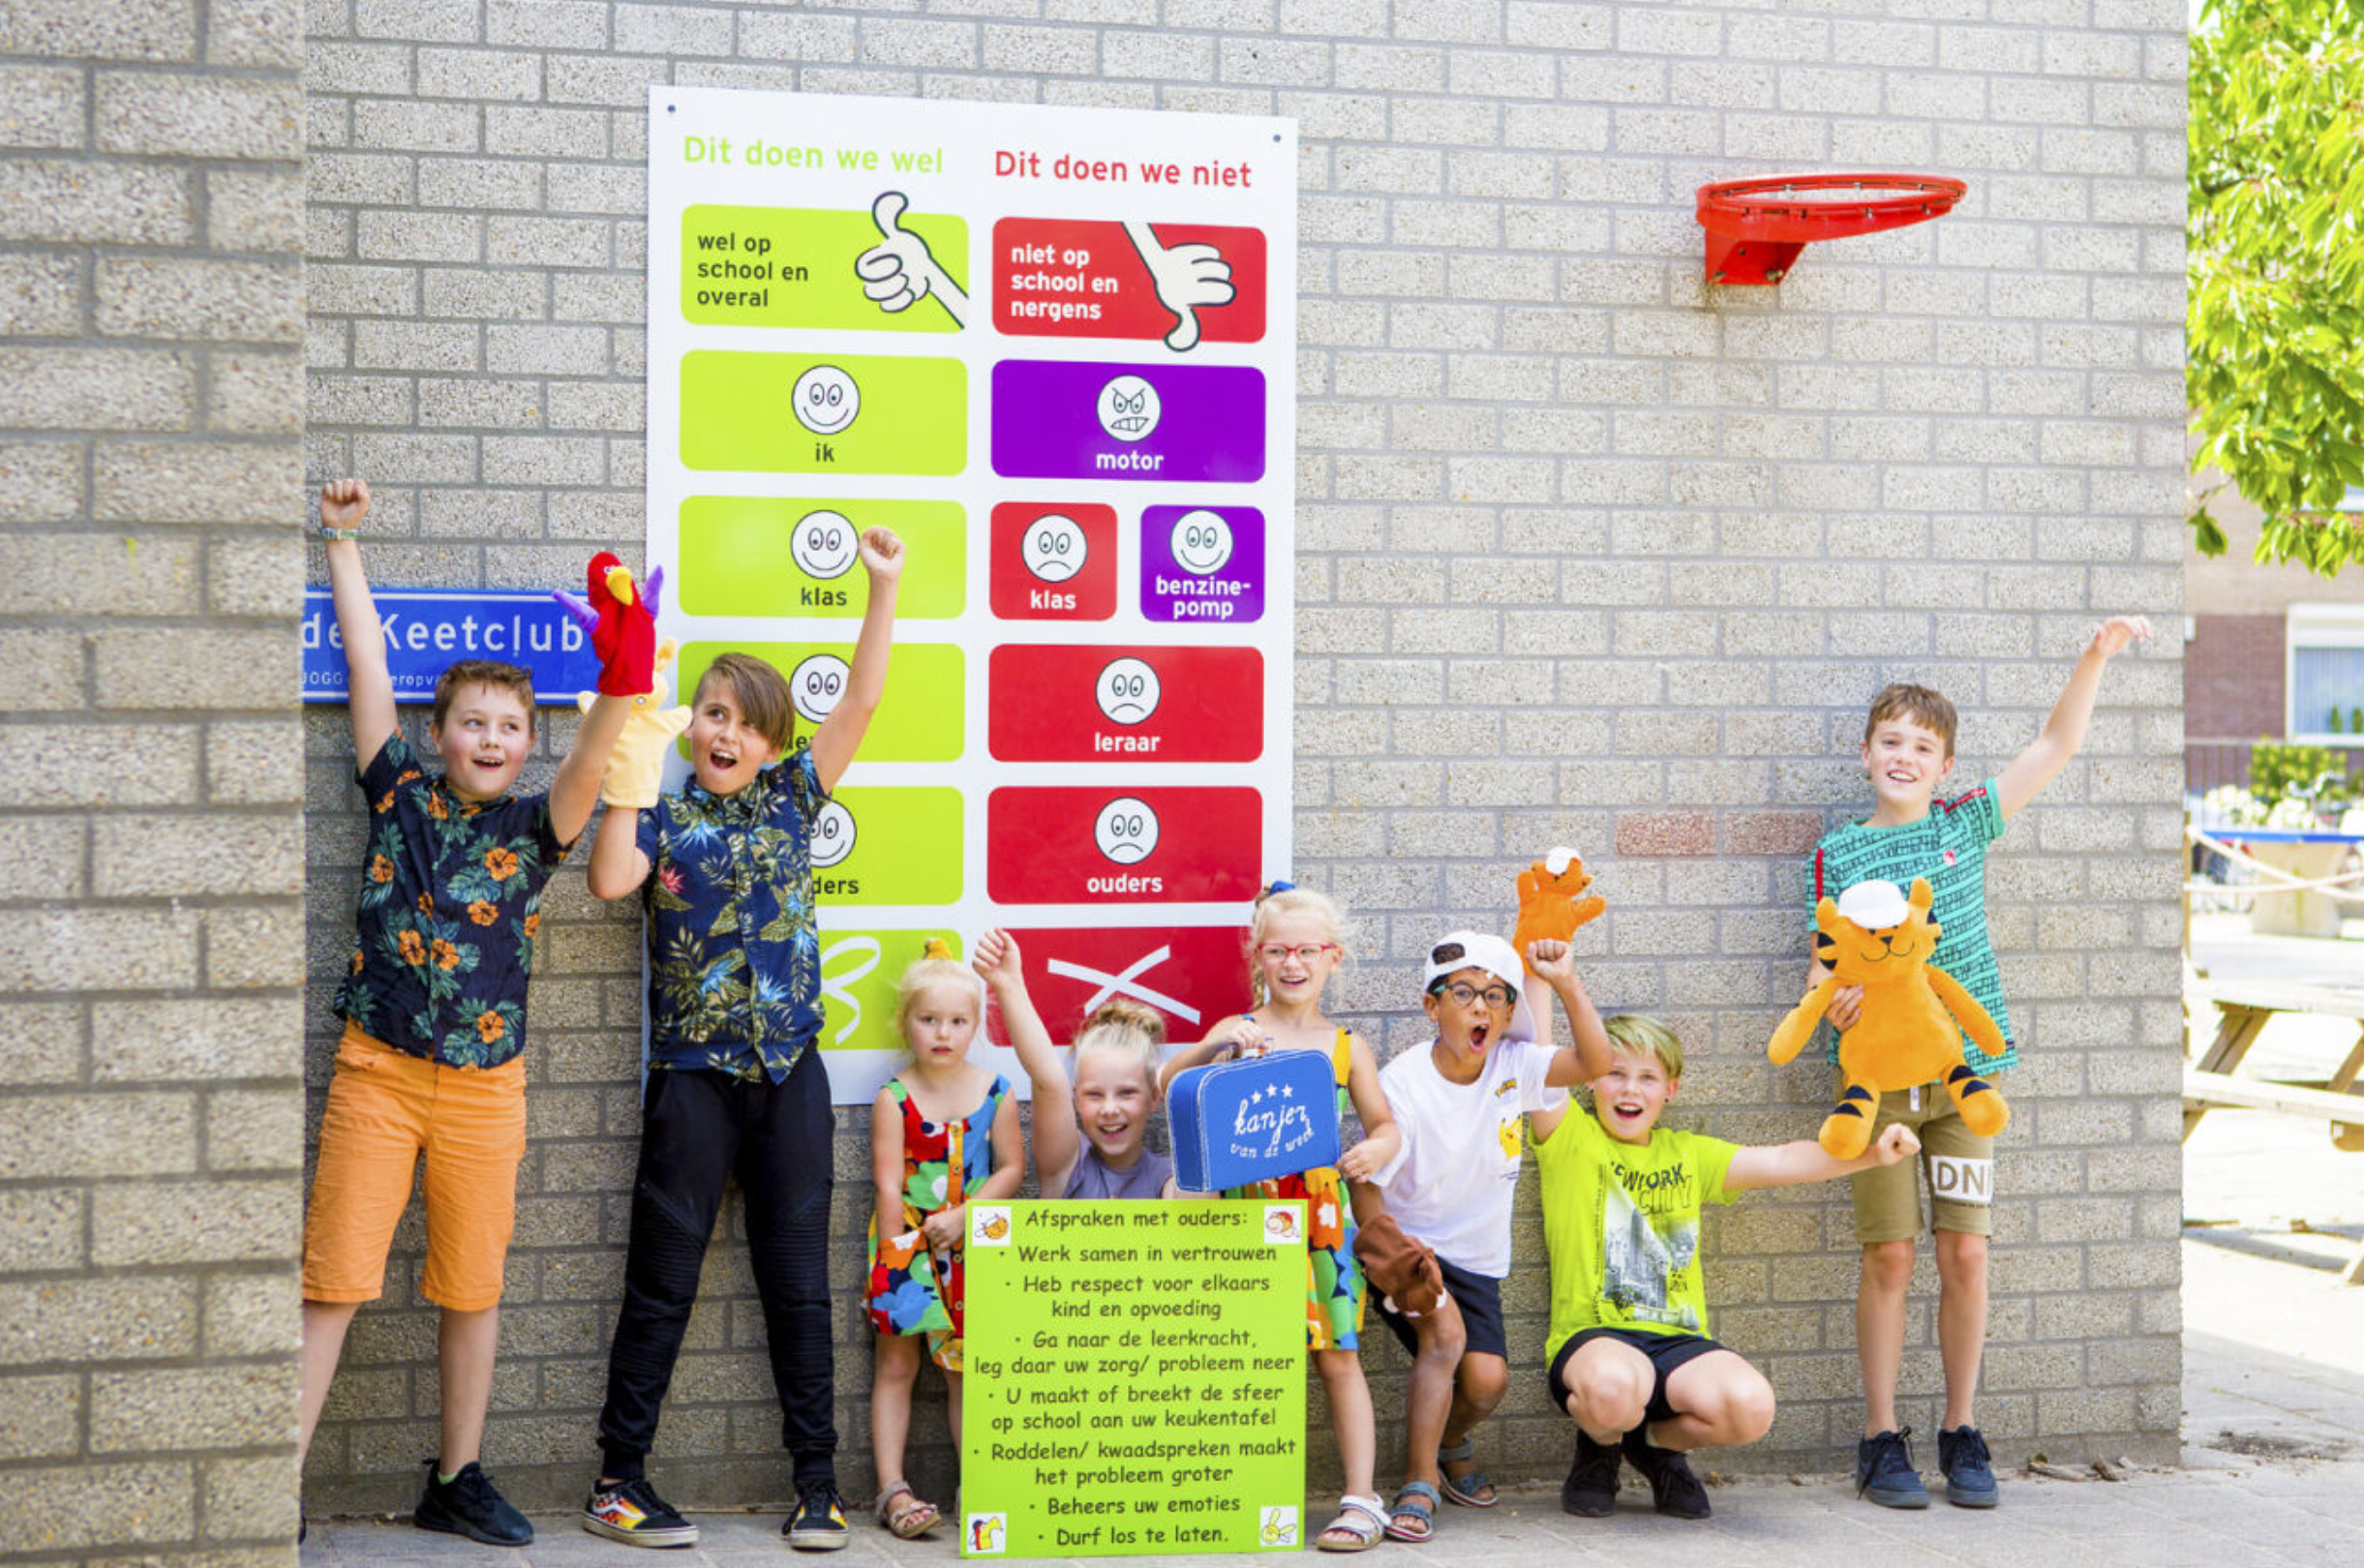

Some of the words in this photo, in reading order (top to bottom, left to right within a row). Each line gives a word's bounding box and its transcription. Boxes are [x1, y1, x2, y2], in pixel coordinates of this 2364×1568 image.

[684, 136, 731, 164] Dit
[745, 140, 823, 167] doen
[837, 150, 878, 170] we
[892, 148, 942, 173] wel
[996, 151, 1040, 177] Dit
[1054, 155, 1127, 181] doen
[1140, 164, 1180, 184] we
[1194, 161, 1251, 187] niet
[698, 232, 735, 251] wel
[744, 237, 771, 256] op
[1012, 243, 1055, 264] niet
[1063, 250, 1089, 269] op
[698, 260, 772, 280] school
[782, 266, 807, 281] en
[1012, 271, 1084, 291] school
[1092, 278, 1118, 293] en
[697, 288, 768, 307] overal
[1012, 301, 1101, 321] nergens
[816, 443, 833, 462] ik
[1097, 450, 1164, 469] motor
[1156, 576, 1251, 595] benzine-
[802, 587, 846, 606] klas
[1031, 589, 1076, 609] klas
[1172, 602, 1232, 620] pomp
[1095, 733, 1161, 751] leraar
[811, 875, 860, 894] ders
[1087, 874, 1163, 892] ouders
[1234, 1099, 1306, 1145] kanjer
[1230, 1143, 1257, 1158] van
[1026, 1210, 1124, 1231] Afspraken
[1134, 1211, 1168, 1225] met
[1178, 1209, 1248, 1225] ouders:
[1018, 1245, 1070, 1261] Werk
[1080, 1250, 1137, 1261] samen
[1148, 1246, 1162, 1260] in
[1172, 1245, 1277, 1260] vertrouwen
[1024, 1276, 1061, 1292] Heb
[1072, 1277, 1143, 1296] respect
[1153, 1280, 1193, 1291] voor
[1201, 1274, 1269, 1291] elkaars
[1052, 1300, 1090, 1316] kind
[1100, 1305, 1121, 1316] en
[1131, 1299, 1221, 1321] opvoeding
[1033, 1331, 1057, 1347] Ga
[1068, 1336, 1109, 1347] naar
[1119, 1330, 1140, 1346] de
[1152, 1329, 1256, 1347] leerkracht,
[975, 1357, 1002, 1378] leg
[1012, 1356, 1055, 1373] daar
[1064, 1361, 1088, 1372] uw
[1098, 1355, 1149, 1376] zorg/
[1159, 1355, 1244, 1376] probleem
[1253, 1358, 1294, 1370] neer
[1007, 1388, 1020, 1404] U
[1031, 1387, 1089, 1403] maakt
[1099, 1385, 1118, 1403] of
[1128, 1384, 1192, 1402] breekt
[1201, 1384, 1222, 1401] de
[1233, 1383, 1284, 1401] sfeer
[992, 1417, 1013, 1434] op
[1023, 1411, 1080, 1430] school
[1091, 1416, 1123, 1428] aan
[1132, 1416, 1156, 1427] uw
[1166, 1408, 1275, 1426] keukentafel
[992, 1442, 1088, 1461] Roddelen/
[1099, 1439, 1229, 1462] kwaadspreken
[1240, 1438, 1295, 1456] maakt
[1036, 1467, 1067, 1485] het
[1076, 1465, 1163, 1489] probleem
[1172, 1466, 1232, 1487] groter
[1048, 1497, 1125, 1515] Beheers
[1135, 1501, 1158, 1513] uw
[1167, 1495, 1240, 1512] emoties
[1057, 1527, 1101, 1546] Durf
[1111, 1526, 1136, 1543] los
[1145, 1528, 1165, 1543] te
[1175, 1525, 1227, 1542] laten.
